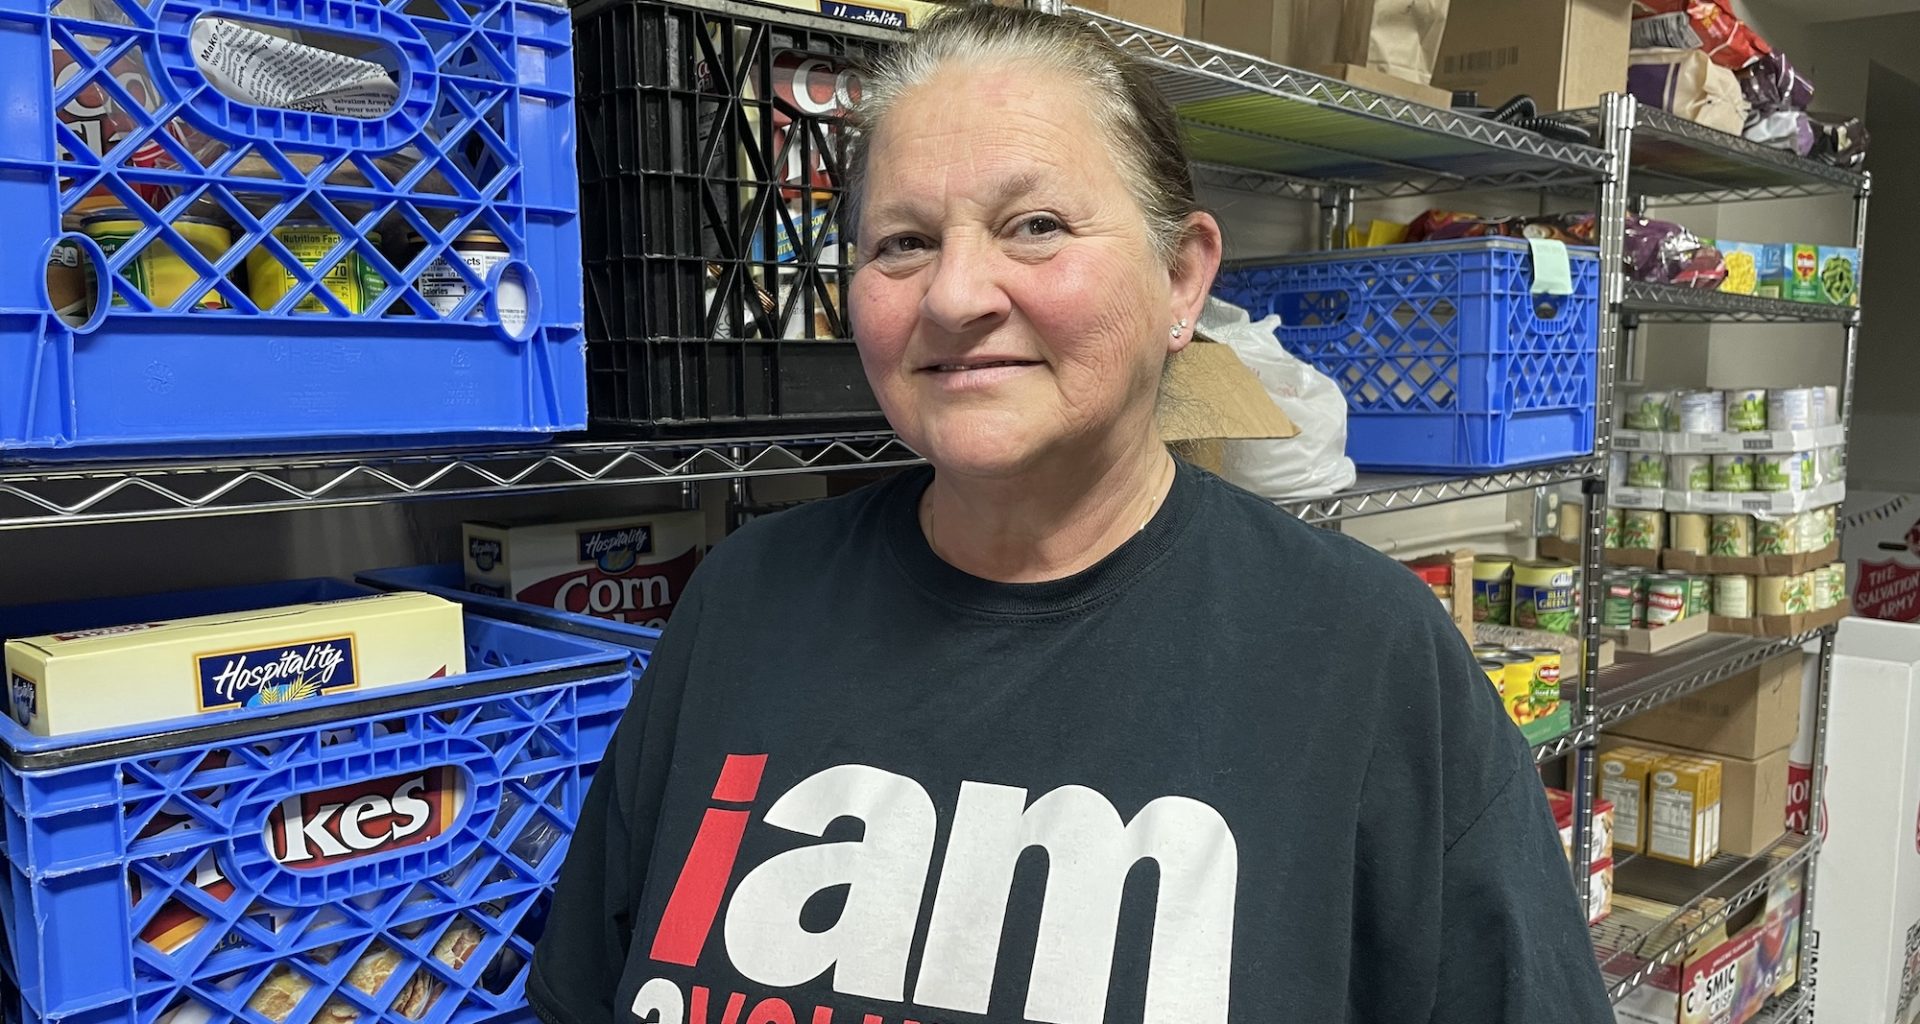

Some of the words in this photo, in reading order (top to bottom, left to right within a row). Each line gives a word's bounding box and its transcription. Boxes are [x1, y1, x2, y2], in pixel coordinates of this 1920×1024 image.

[833, 5, 903, 25] Hpitality
[200, 33, 219, 61] Make
[283, 234, 320, 243] Nutrition
[335, 265, 347, 276] 70
[423, 287, 448, 295] Calories
[585, 528, 648, 557] Hospitality
[1869, 564, 1896, 585] THE
[554, 575, 678, 615] Corn
[1858, 571, 1920, 610] SALVATION
[1879, 592, 1917, 619] ARMY
[213, 643, 344, 699] Hospitality
